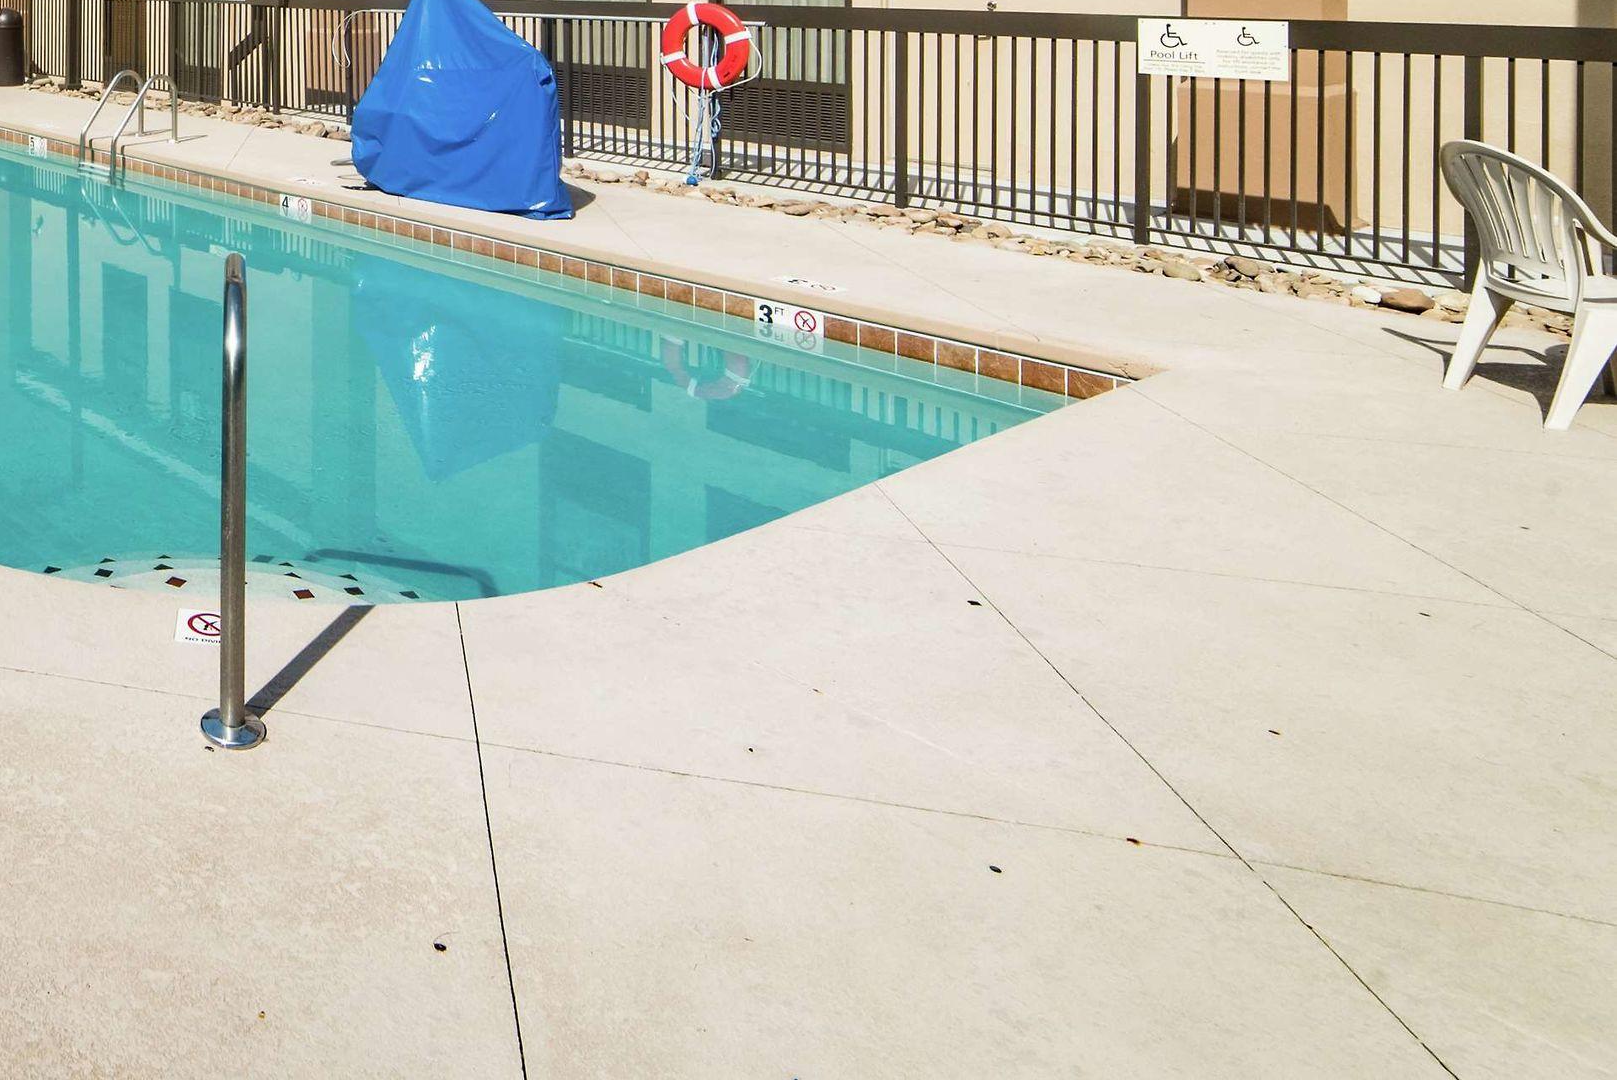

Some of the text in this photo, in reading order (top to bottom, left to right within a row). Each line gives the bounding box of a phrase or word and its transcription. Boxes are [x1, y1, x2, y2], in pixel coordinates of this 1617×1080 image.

[1150, 50, 1198, 61] Pool Lift
[282, 196, 289, 208] 4
[759, 304, 784, 323] 3 FT
